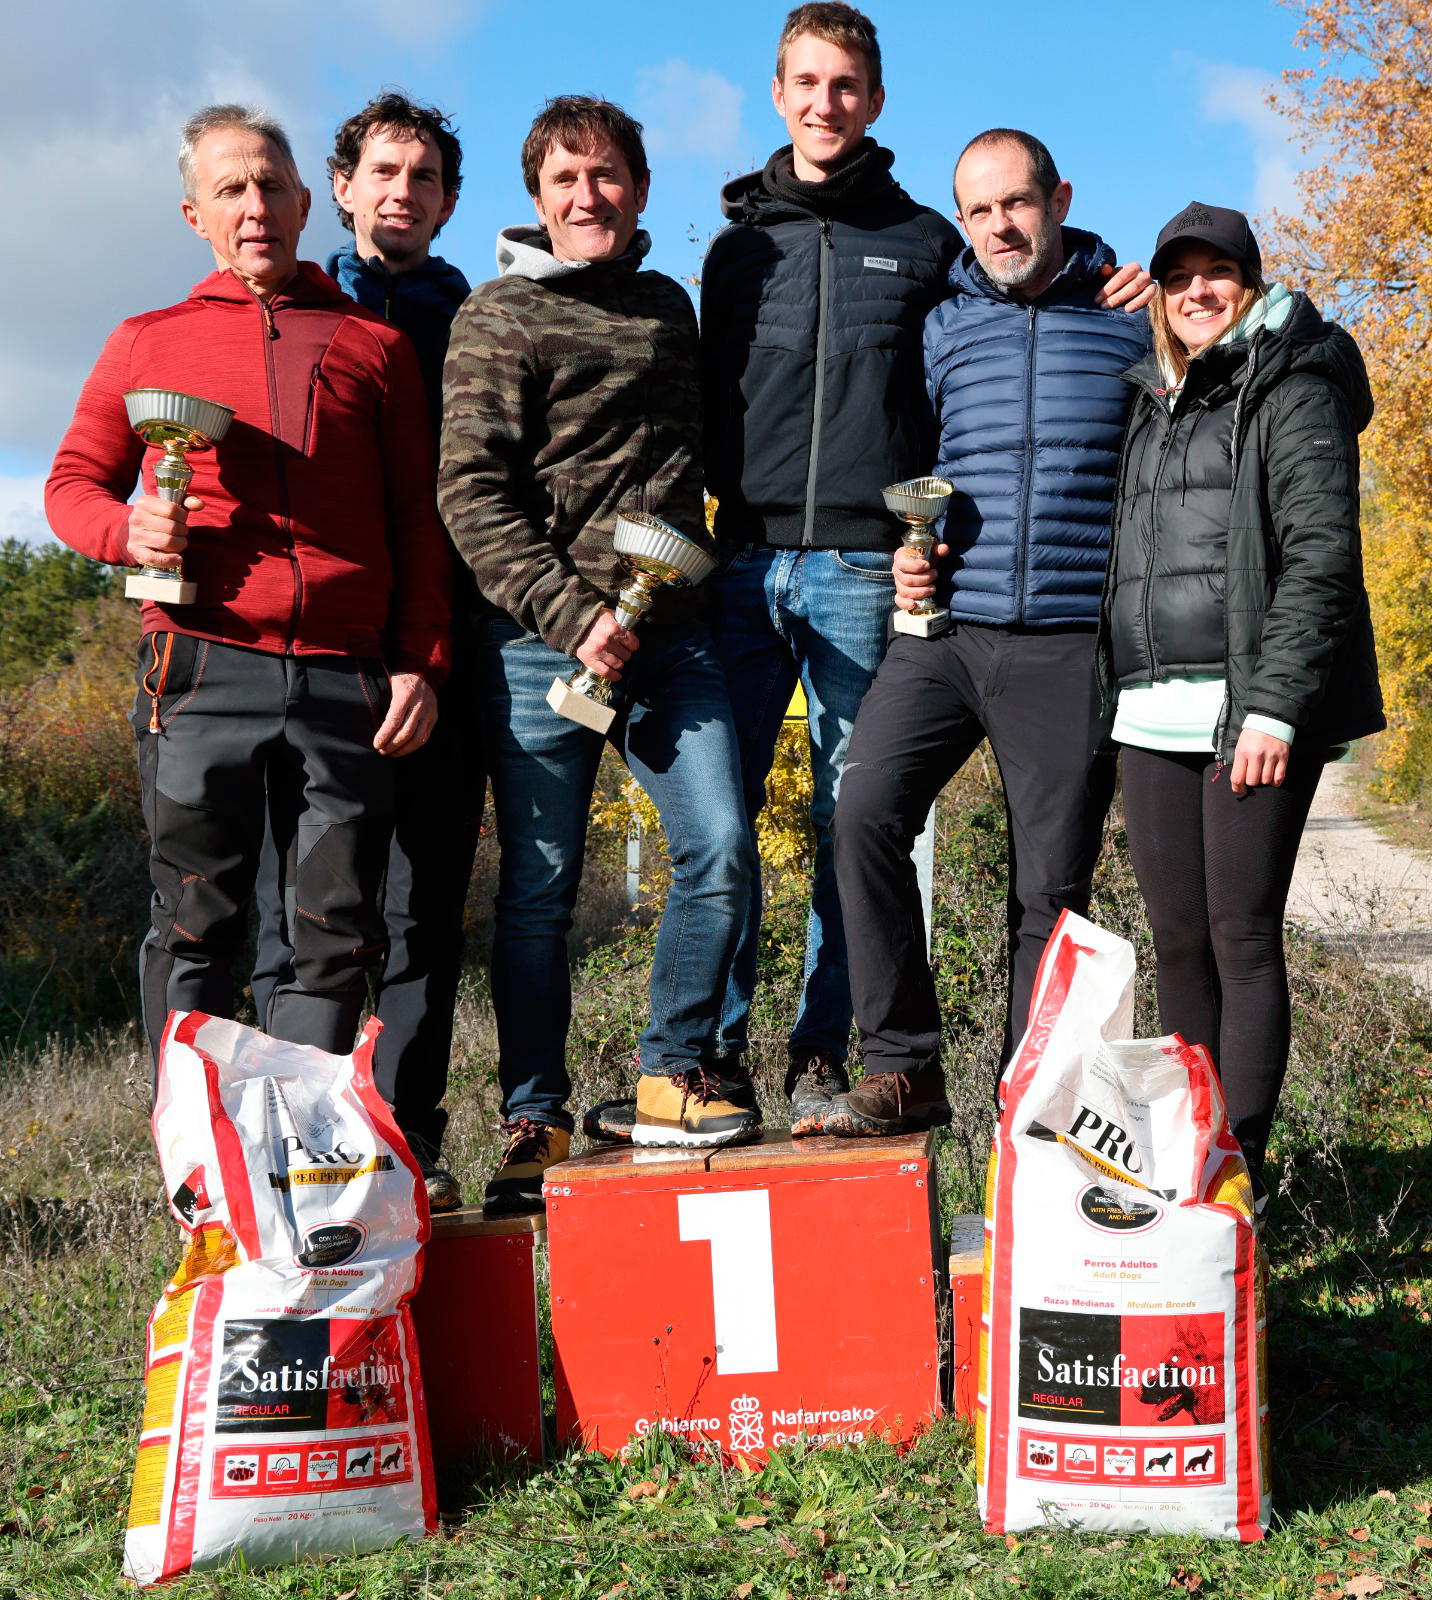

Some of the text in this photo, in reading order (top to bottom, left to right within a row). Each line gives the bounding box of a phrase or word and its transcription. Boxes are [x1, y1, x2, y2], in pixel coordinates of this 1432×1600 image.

[1066, 1105, 1143, 1174] PRO
[1095, 1161, 1138, 1187] PREMI
[1084, 1259, 1158, 1269] Perros Adultos
[678, 1189, 778, 1375] 1
[1093, 1271, 1142, 1280] Adult Dogs
[328, 1280, 348, 1288] Dogs
[1044, 1296, 1196, 1309] Razas Medianas Medium Breeds
[335, 1306, 368, 1314] Medium
[240, 1354, 401, 1393] Satisfaction
[1037, 1348, 1217, 1388] Satisfaction
[1032, 1393, 1084, 1407] REGULAR
[234, 1405, 290, 1416] REGULAR
[772, 1406, 876, 1426] Nafarroako
